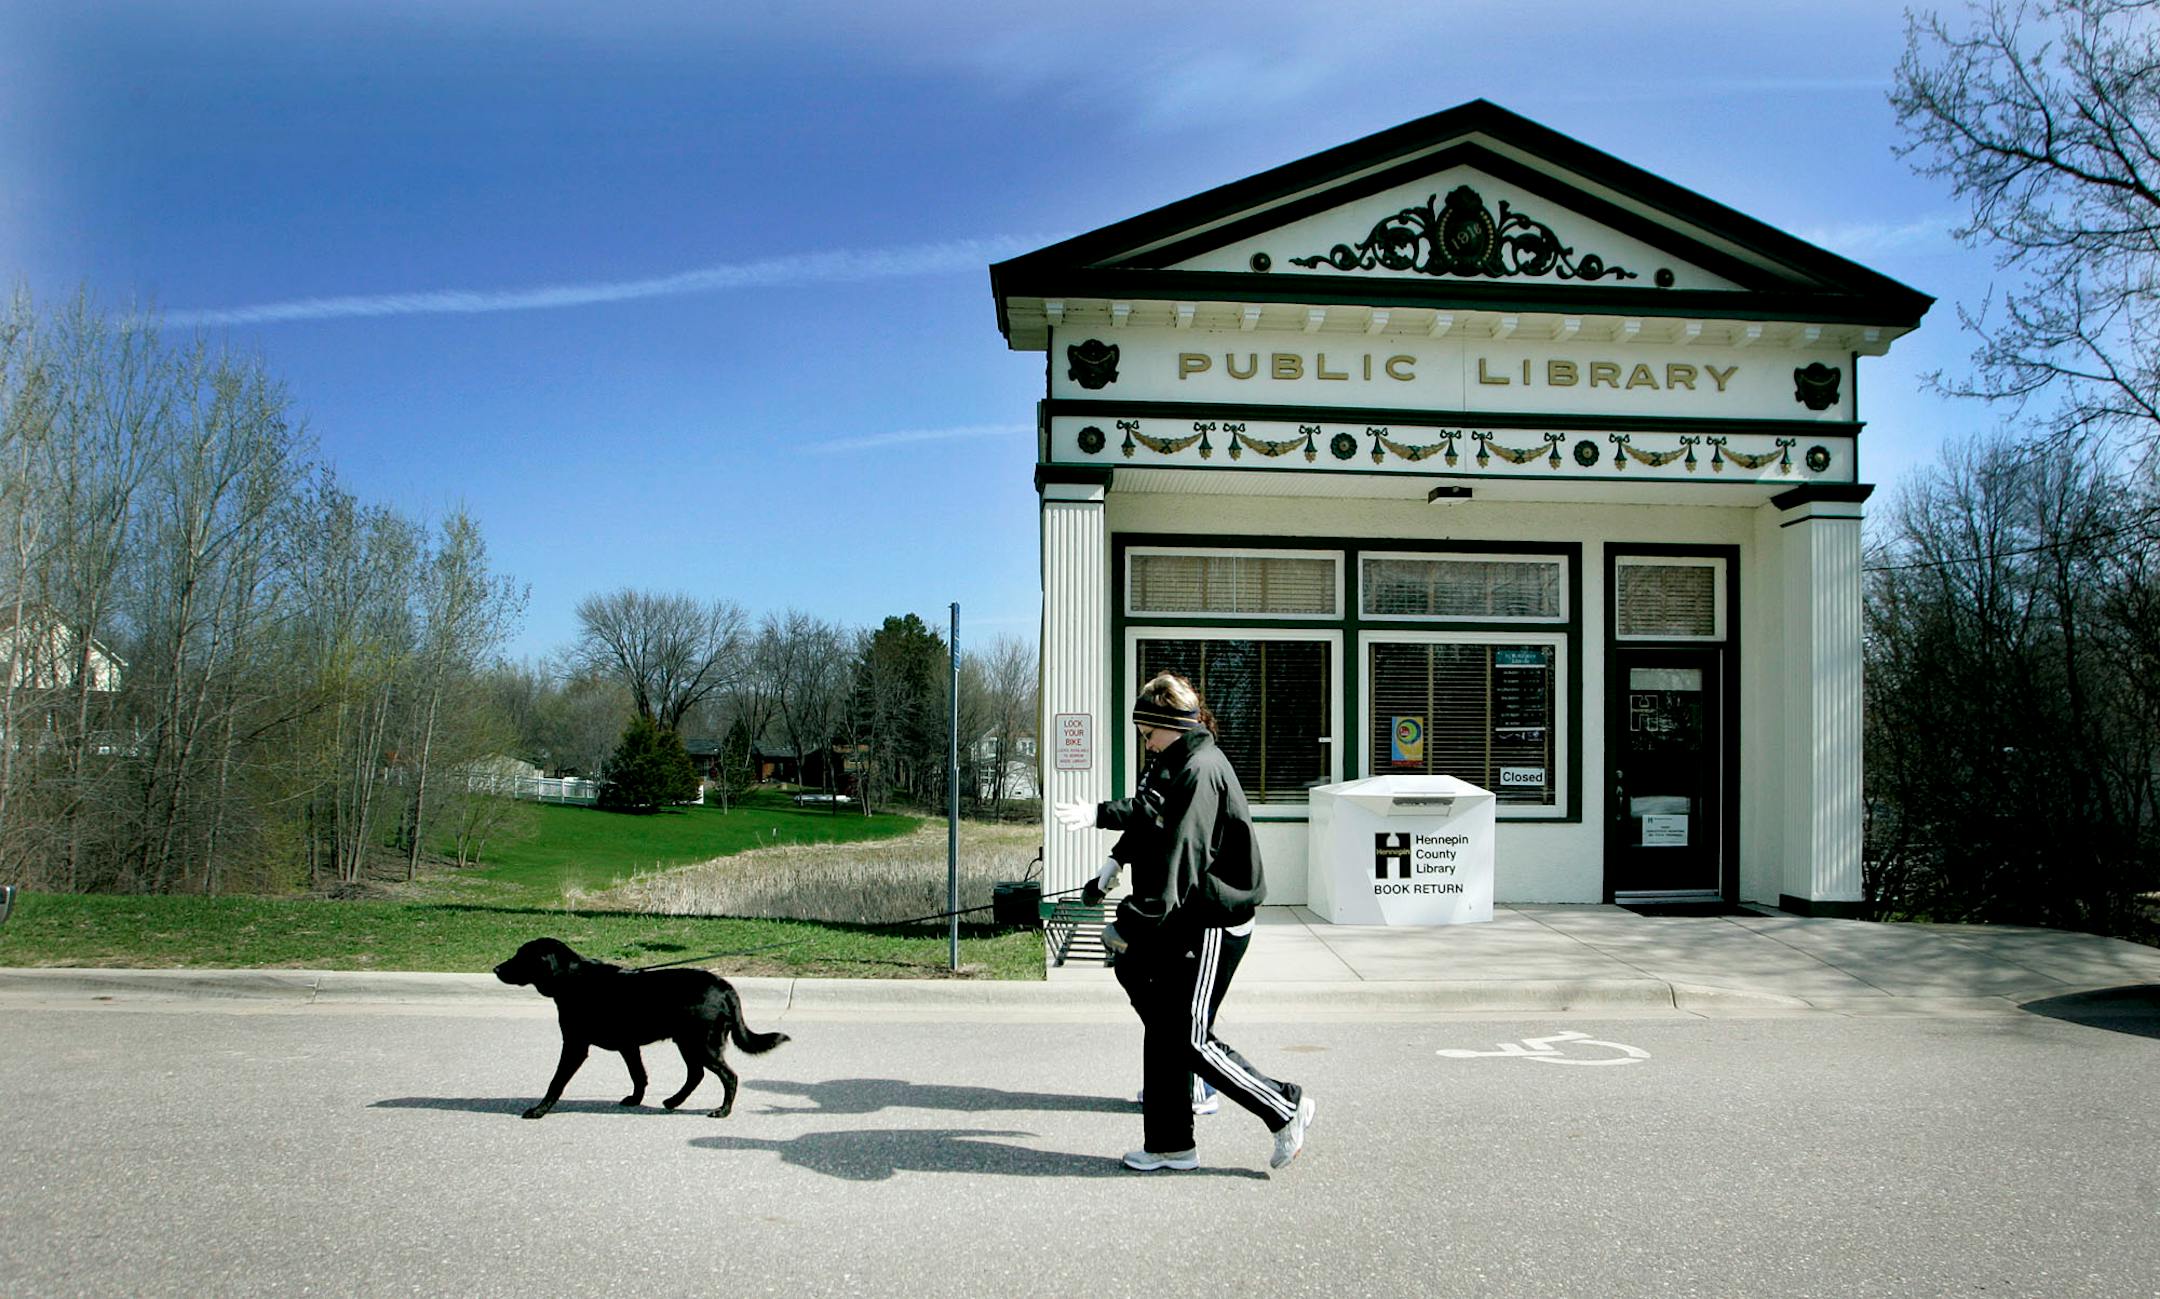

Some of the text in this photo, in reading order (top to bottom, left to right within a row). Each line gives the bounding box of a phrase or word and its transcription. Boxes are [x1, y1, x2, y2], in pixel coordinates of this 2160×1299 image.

[1178, 353, 1739, 392] PUBLIC LIBRARY
[1063, 719, 1084, 728] LOCK
[1063, 729, 1084, 737] YOUR
[1065, 738, 1082, 746] BIKE
[1502, 771, 1543, 783] Closed
[1415, 834, 1469, 847] Hennepin
[1376, 848, 1411, 857] Hennepin
[1415, 848, 1457, 862] County
[1416, 863, 1456, 876] Library
[1374, 884, 1464, 895] BOOK RETURN
